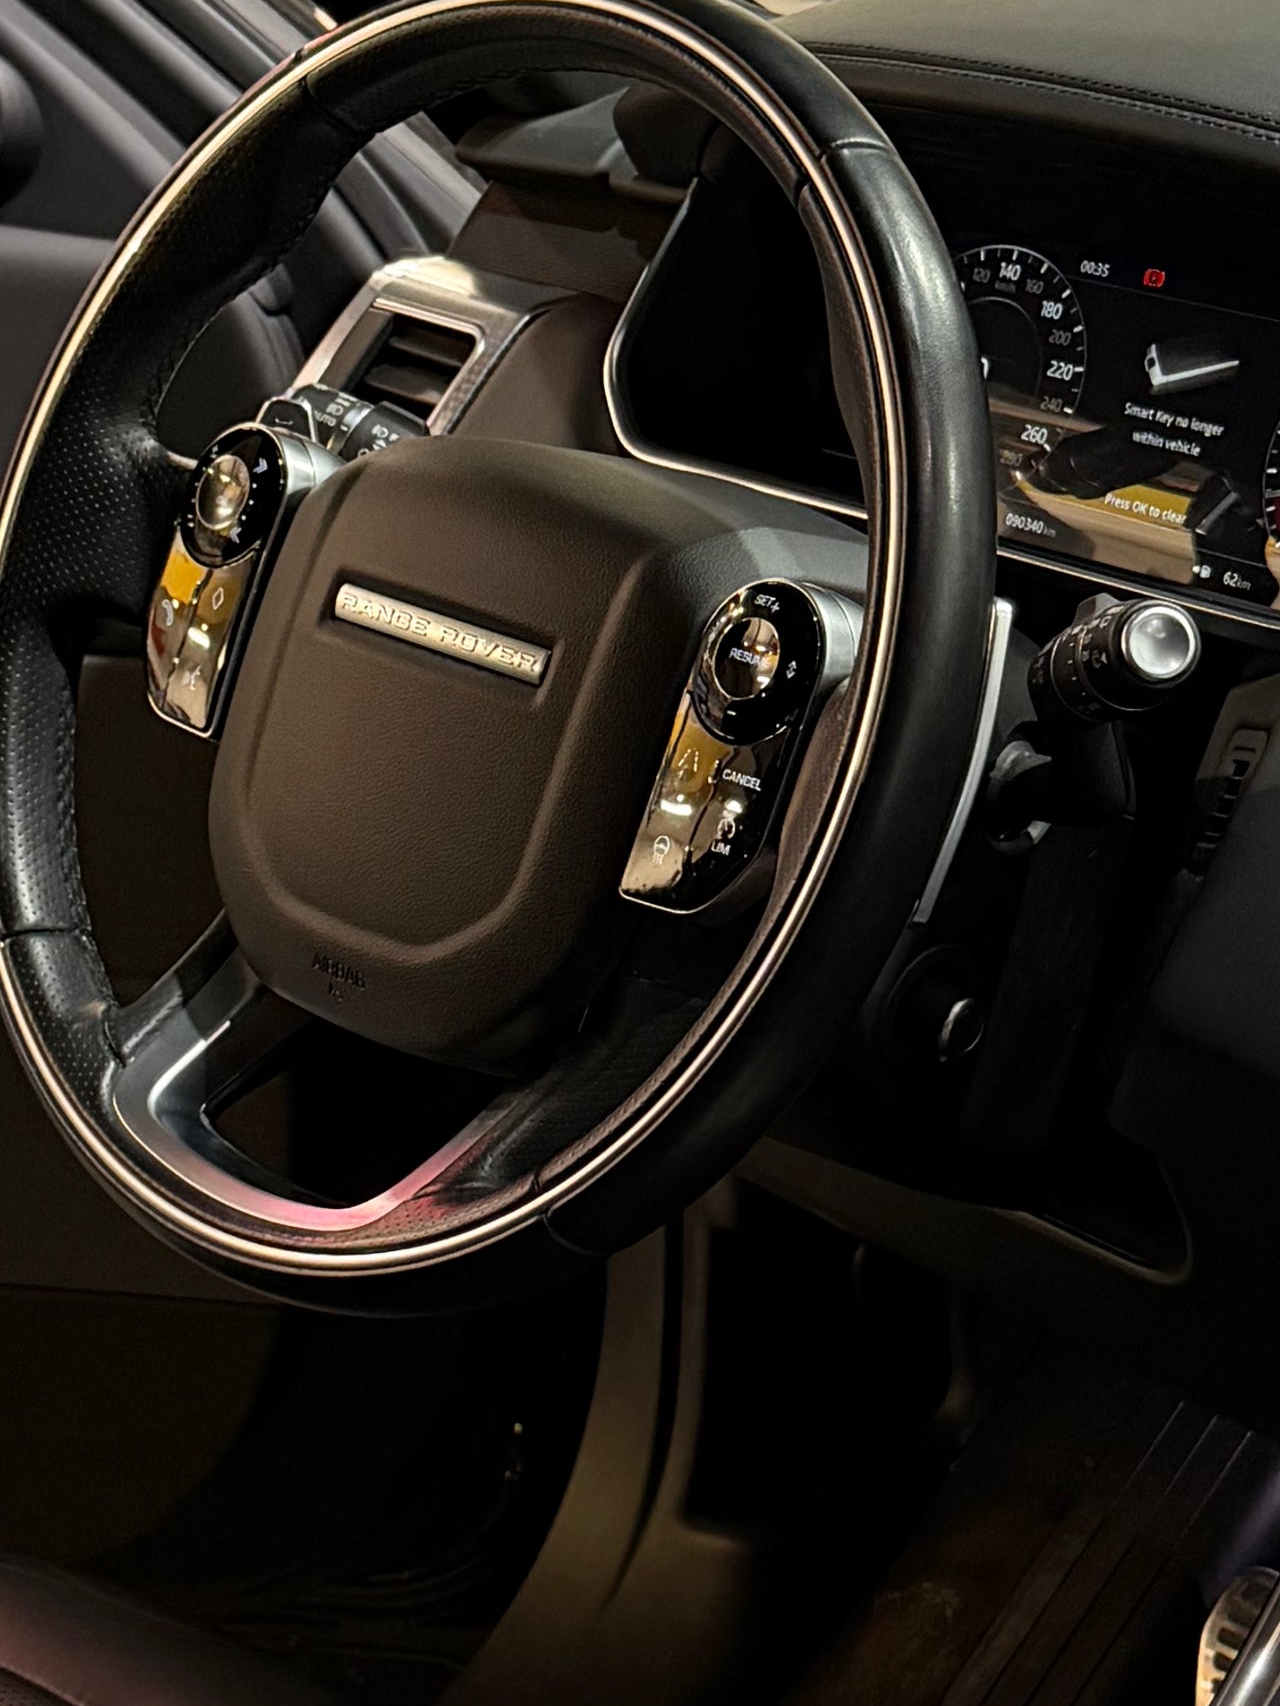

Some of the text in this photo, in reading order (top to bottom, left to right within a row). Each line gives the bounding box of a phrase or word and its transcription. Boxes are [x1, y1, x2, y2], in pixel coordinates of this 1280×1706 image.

[998, 261, 1022, 282] 140
[1079, 258, 1111, 278] 00:35
[1040, 299, 1064, 321] 180
[1046, 359, 1074, 382] 220
[1123, 401, 1226, 438] Smart Key no longer
[1020, 423, 1049, 446] 260
[1131, 429, 1202, 458] within vehicle
[1103, 492, 1188, 525] Press OK to clear
[341, 592, 539, 674] RANGE ROVER
[721, 768, 763, 792] CANCEL
